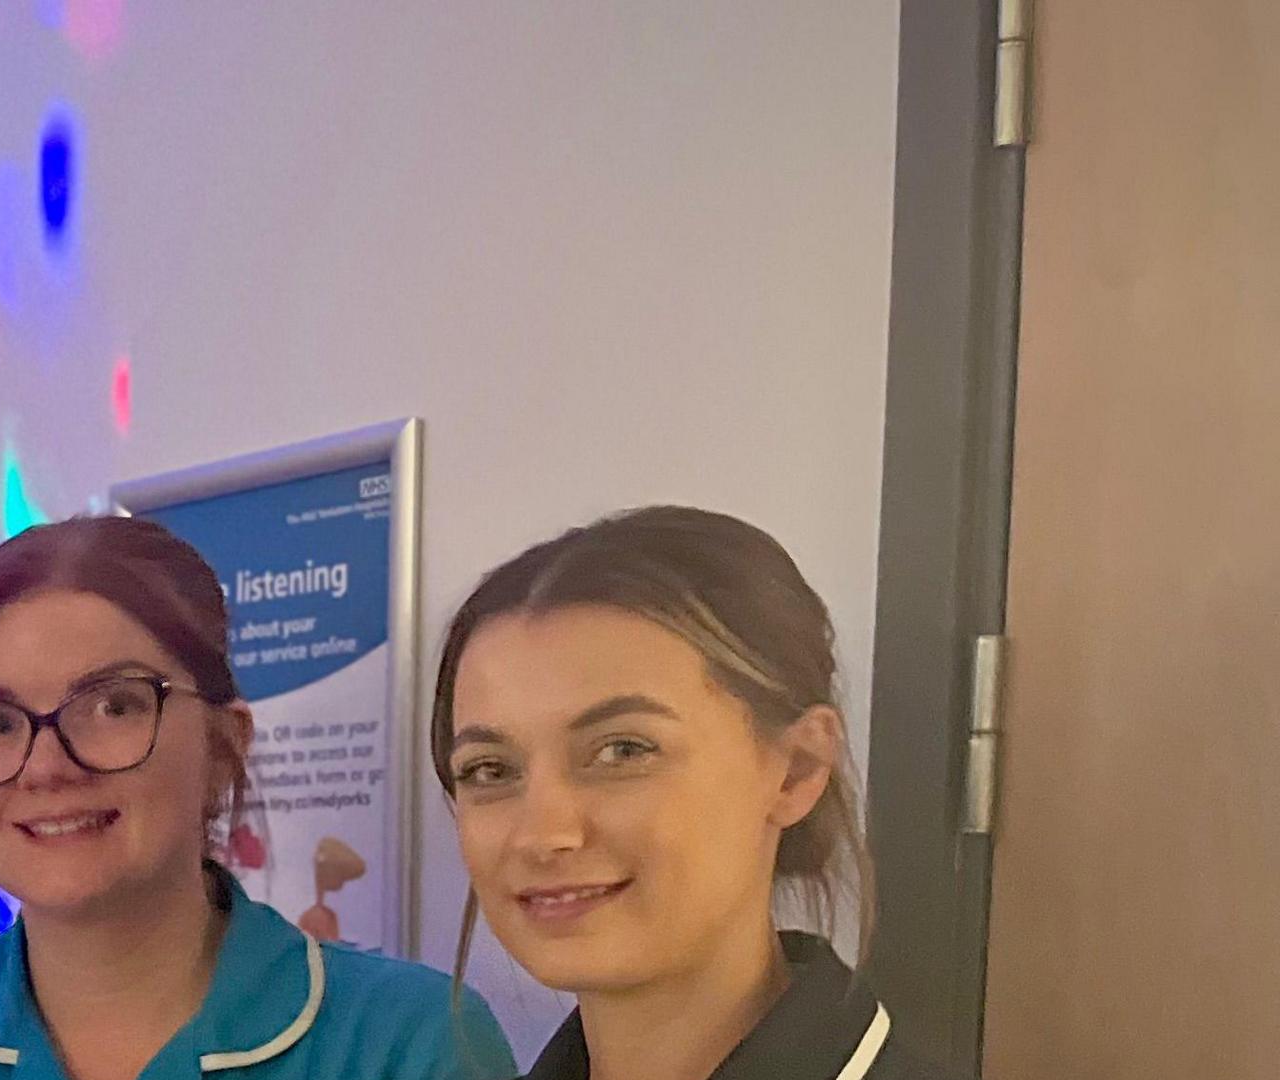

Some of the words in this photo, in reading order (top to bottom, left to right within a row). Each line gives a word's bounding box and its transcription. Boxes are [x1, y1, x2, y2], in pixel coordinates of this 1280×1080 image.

[361, 477, 389, 496] NHS
[236, 559, 348, 604] listening
[240, 620, 279, 640] about
[282, 617, 317, 638] your
[260, 645, 307, 663] service
[310, 636, 357, 658] online
[273, 725, 291, 742] QR
[295, 723, 325, 738] code
[347, 721, 379, 739] your
